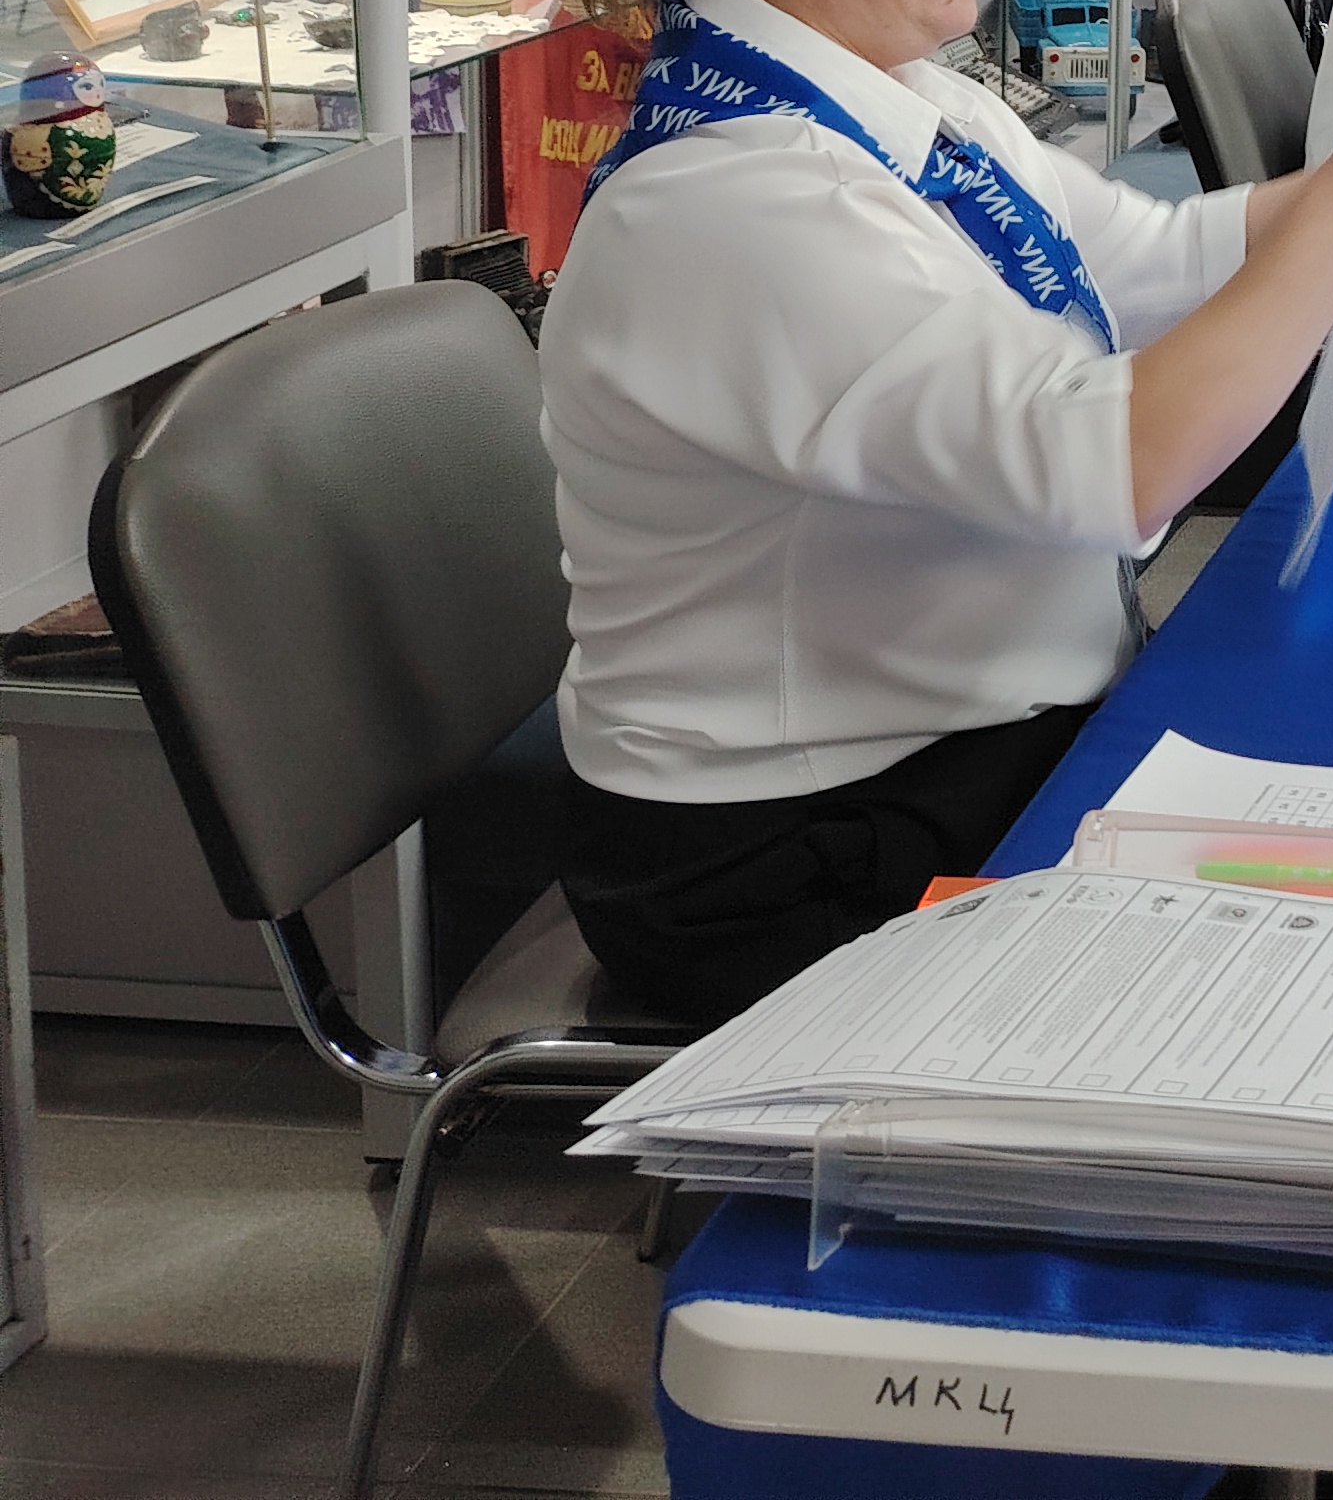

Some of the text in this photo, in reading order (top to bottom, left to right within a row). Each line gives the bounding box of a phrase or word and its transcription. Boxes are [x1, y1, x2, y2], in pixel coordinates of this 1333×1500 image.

[576, 50, 611, 94] ЗА
[684, 61, 758, 106] УИК
[970, 166, 1024, 235] УИК
[1012, 233, 1066, 303] УИК
[875, 1375, 1014, 1435] МКЦ
